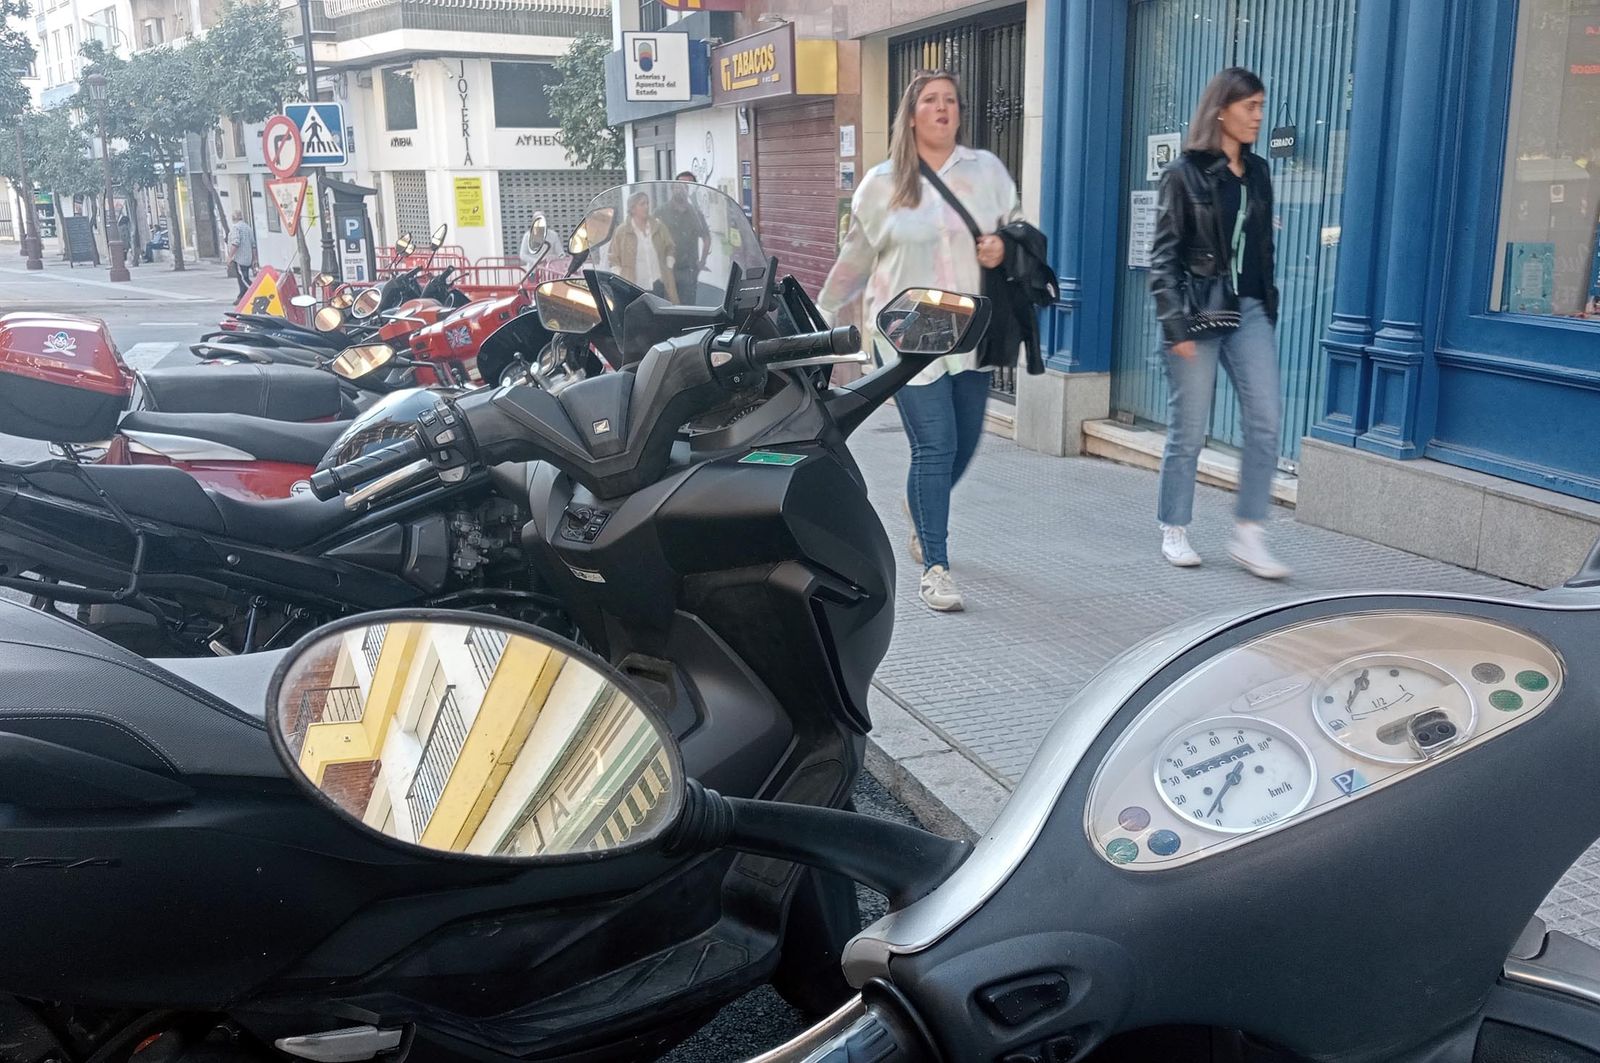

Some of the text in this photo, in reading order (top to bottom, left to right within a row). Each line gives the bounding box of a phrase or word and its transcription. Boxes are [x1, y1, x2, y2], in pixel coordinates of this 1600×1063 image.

[732, 43, 775, 78] TABACOS
[458, 60, 474, 166] JOYERIA
[515, 134, 564, 146] ATHEN
[1270, 137, 1294, 147] CERRADO
[345, 219, 359, 236] P
[1371, 697, 1387, 709] 1/2
[1209, 736, 1220, 747] 60
[1233, 735, 1245, 745] 70
[1187, 745, 1198, 756] 50
[1258, 741, 1270, 751] 80
[1173, 758, 1184, 769] 40
[1169, 776, 1181, 787] 30
[1268, 782, 1293, 798] km/h
[1175, 794, 1187, 806] 20
[1192, 808, 1204, 820] 10
[1215, 818, 1223, 828] 0
